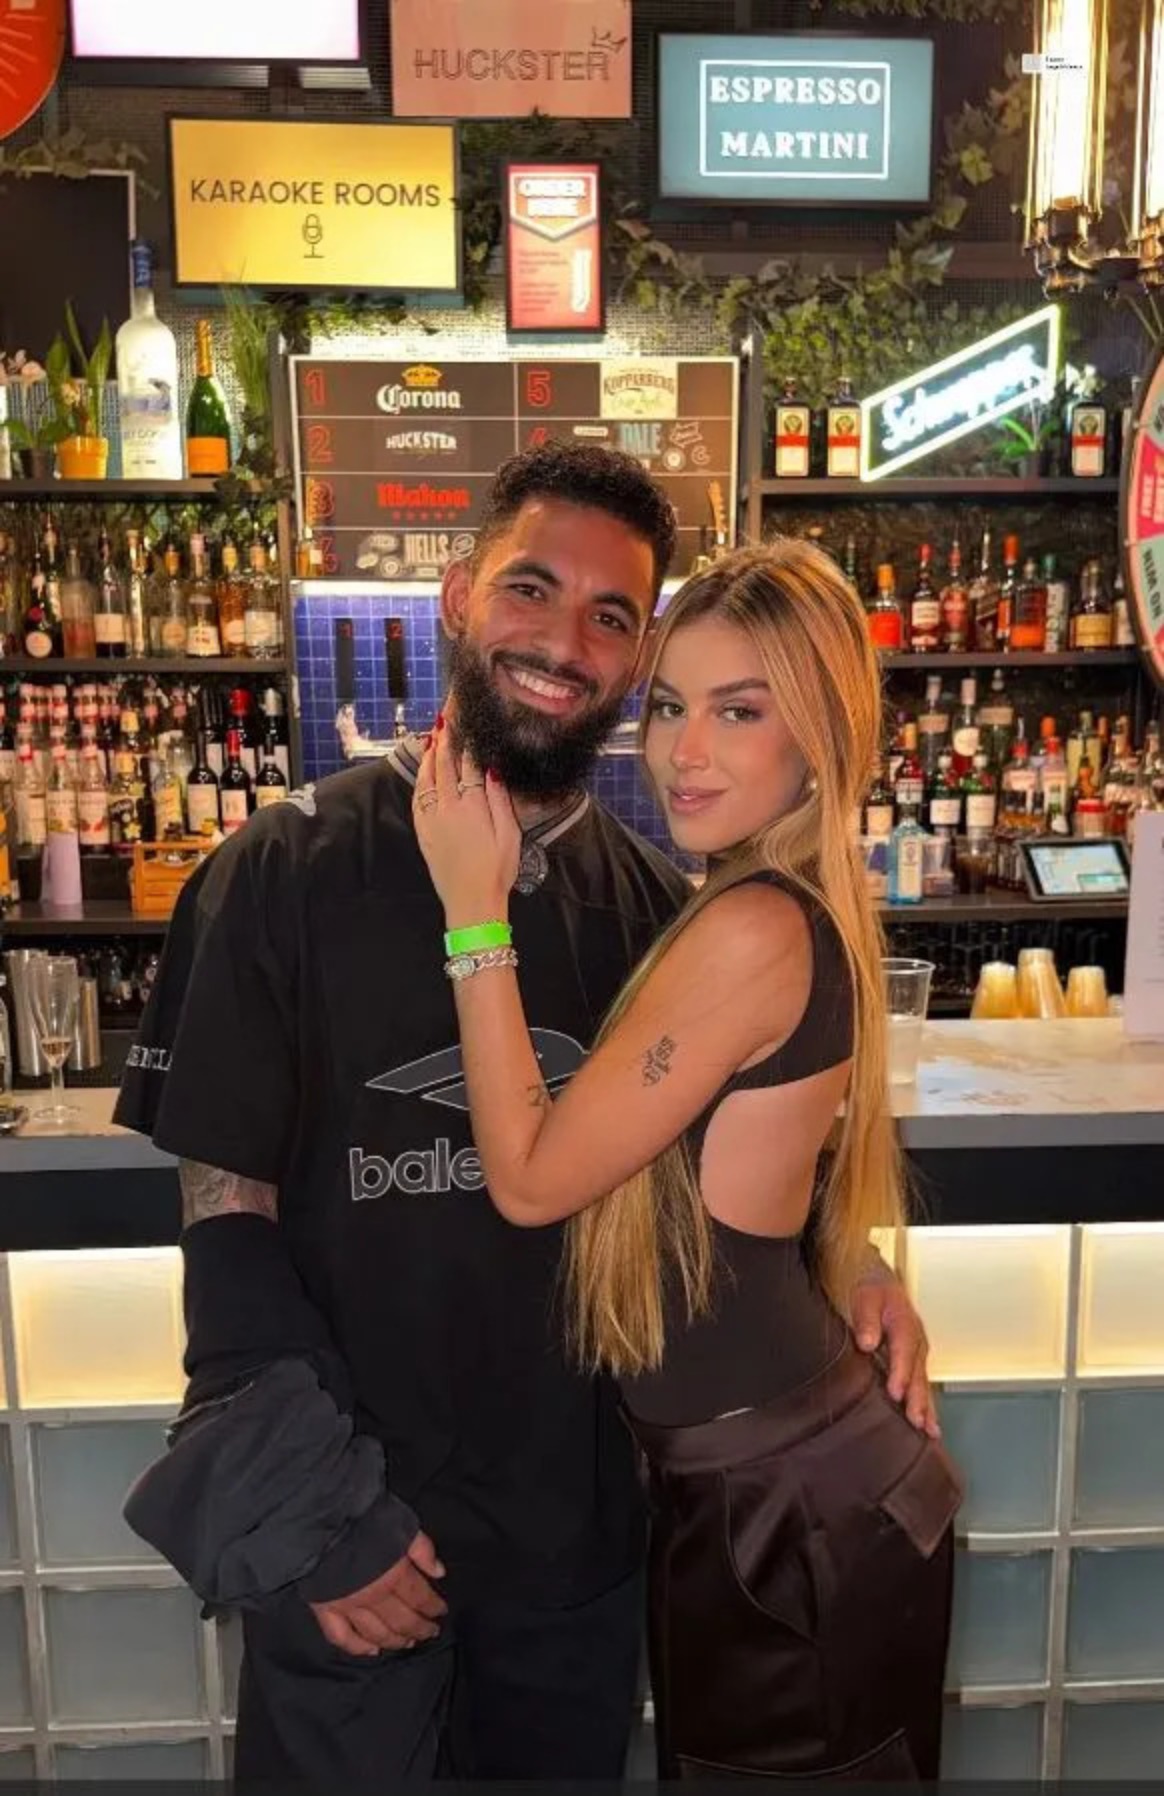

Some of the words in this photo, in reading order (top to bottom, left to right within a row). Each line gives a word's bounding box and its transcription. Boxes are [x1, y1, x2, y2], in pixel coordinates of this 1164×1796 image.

[414, 48, 610, 81] HUCKSTER
[710, 76, 881, 105] ESPRESSO
[720, 131, 869, 159] MARTINI
[190, 179, 324, 205] KARAOKE
[335, 182, 441, 207] ROOMS
[376, 383, 462, 415] Corona
[527, 371, 551, 407] 5
[307, 425, 333, 463] 2
[385, 431, 457, 449] HUCKSTER
[404, 533, 449, 565] HELLS
[349, 1138, 486, 1201] bale
